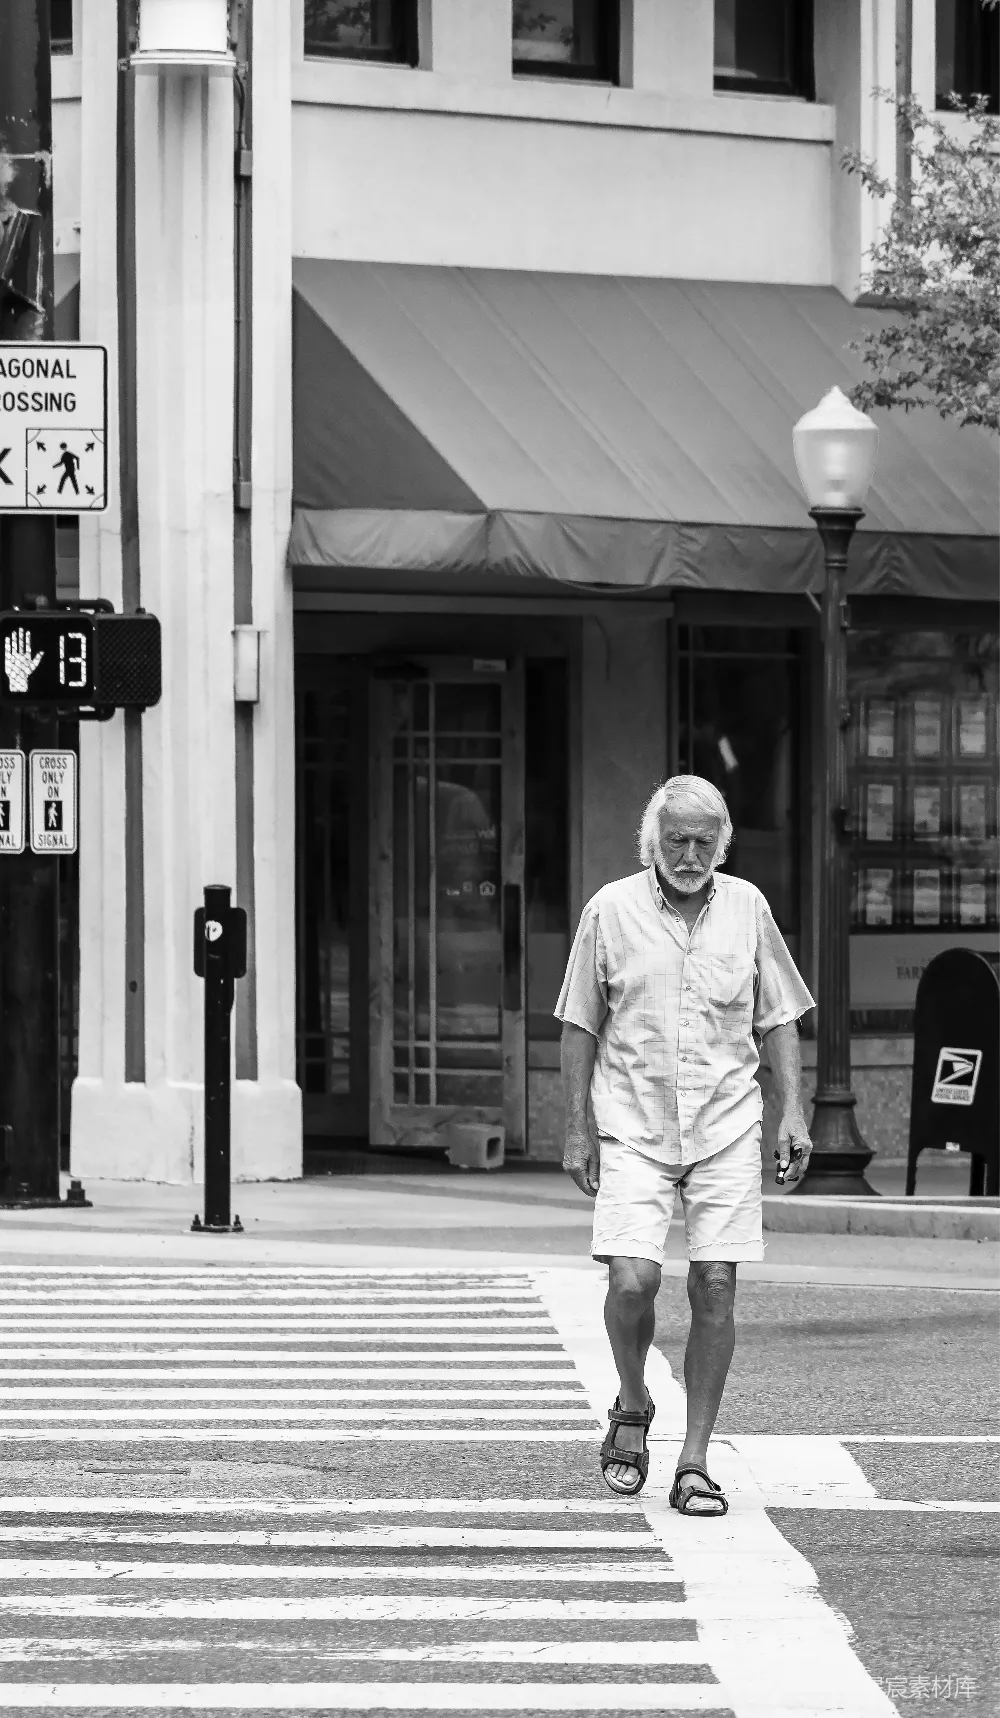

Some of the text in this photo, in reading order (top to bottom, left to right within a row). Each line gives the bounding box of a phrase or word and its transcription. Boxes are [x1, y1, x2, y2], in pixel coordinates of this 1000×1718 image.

[0, 391, 77, 412] OSSING
[59, 632, 87, 687] 13
[39, 757, 67, 769] CROSS
[41, 771, 64, 784] ONLY
[47, 785, 60, 798] ON
[38, 834, 68, 847] SIGNAL
